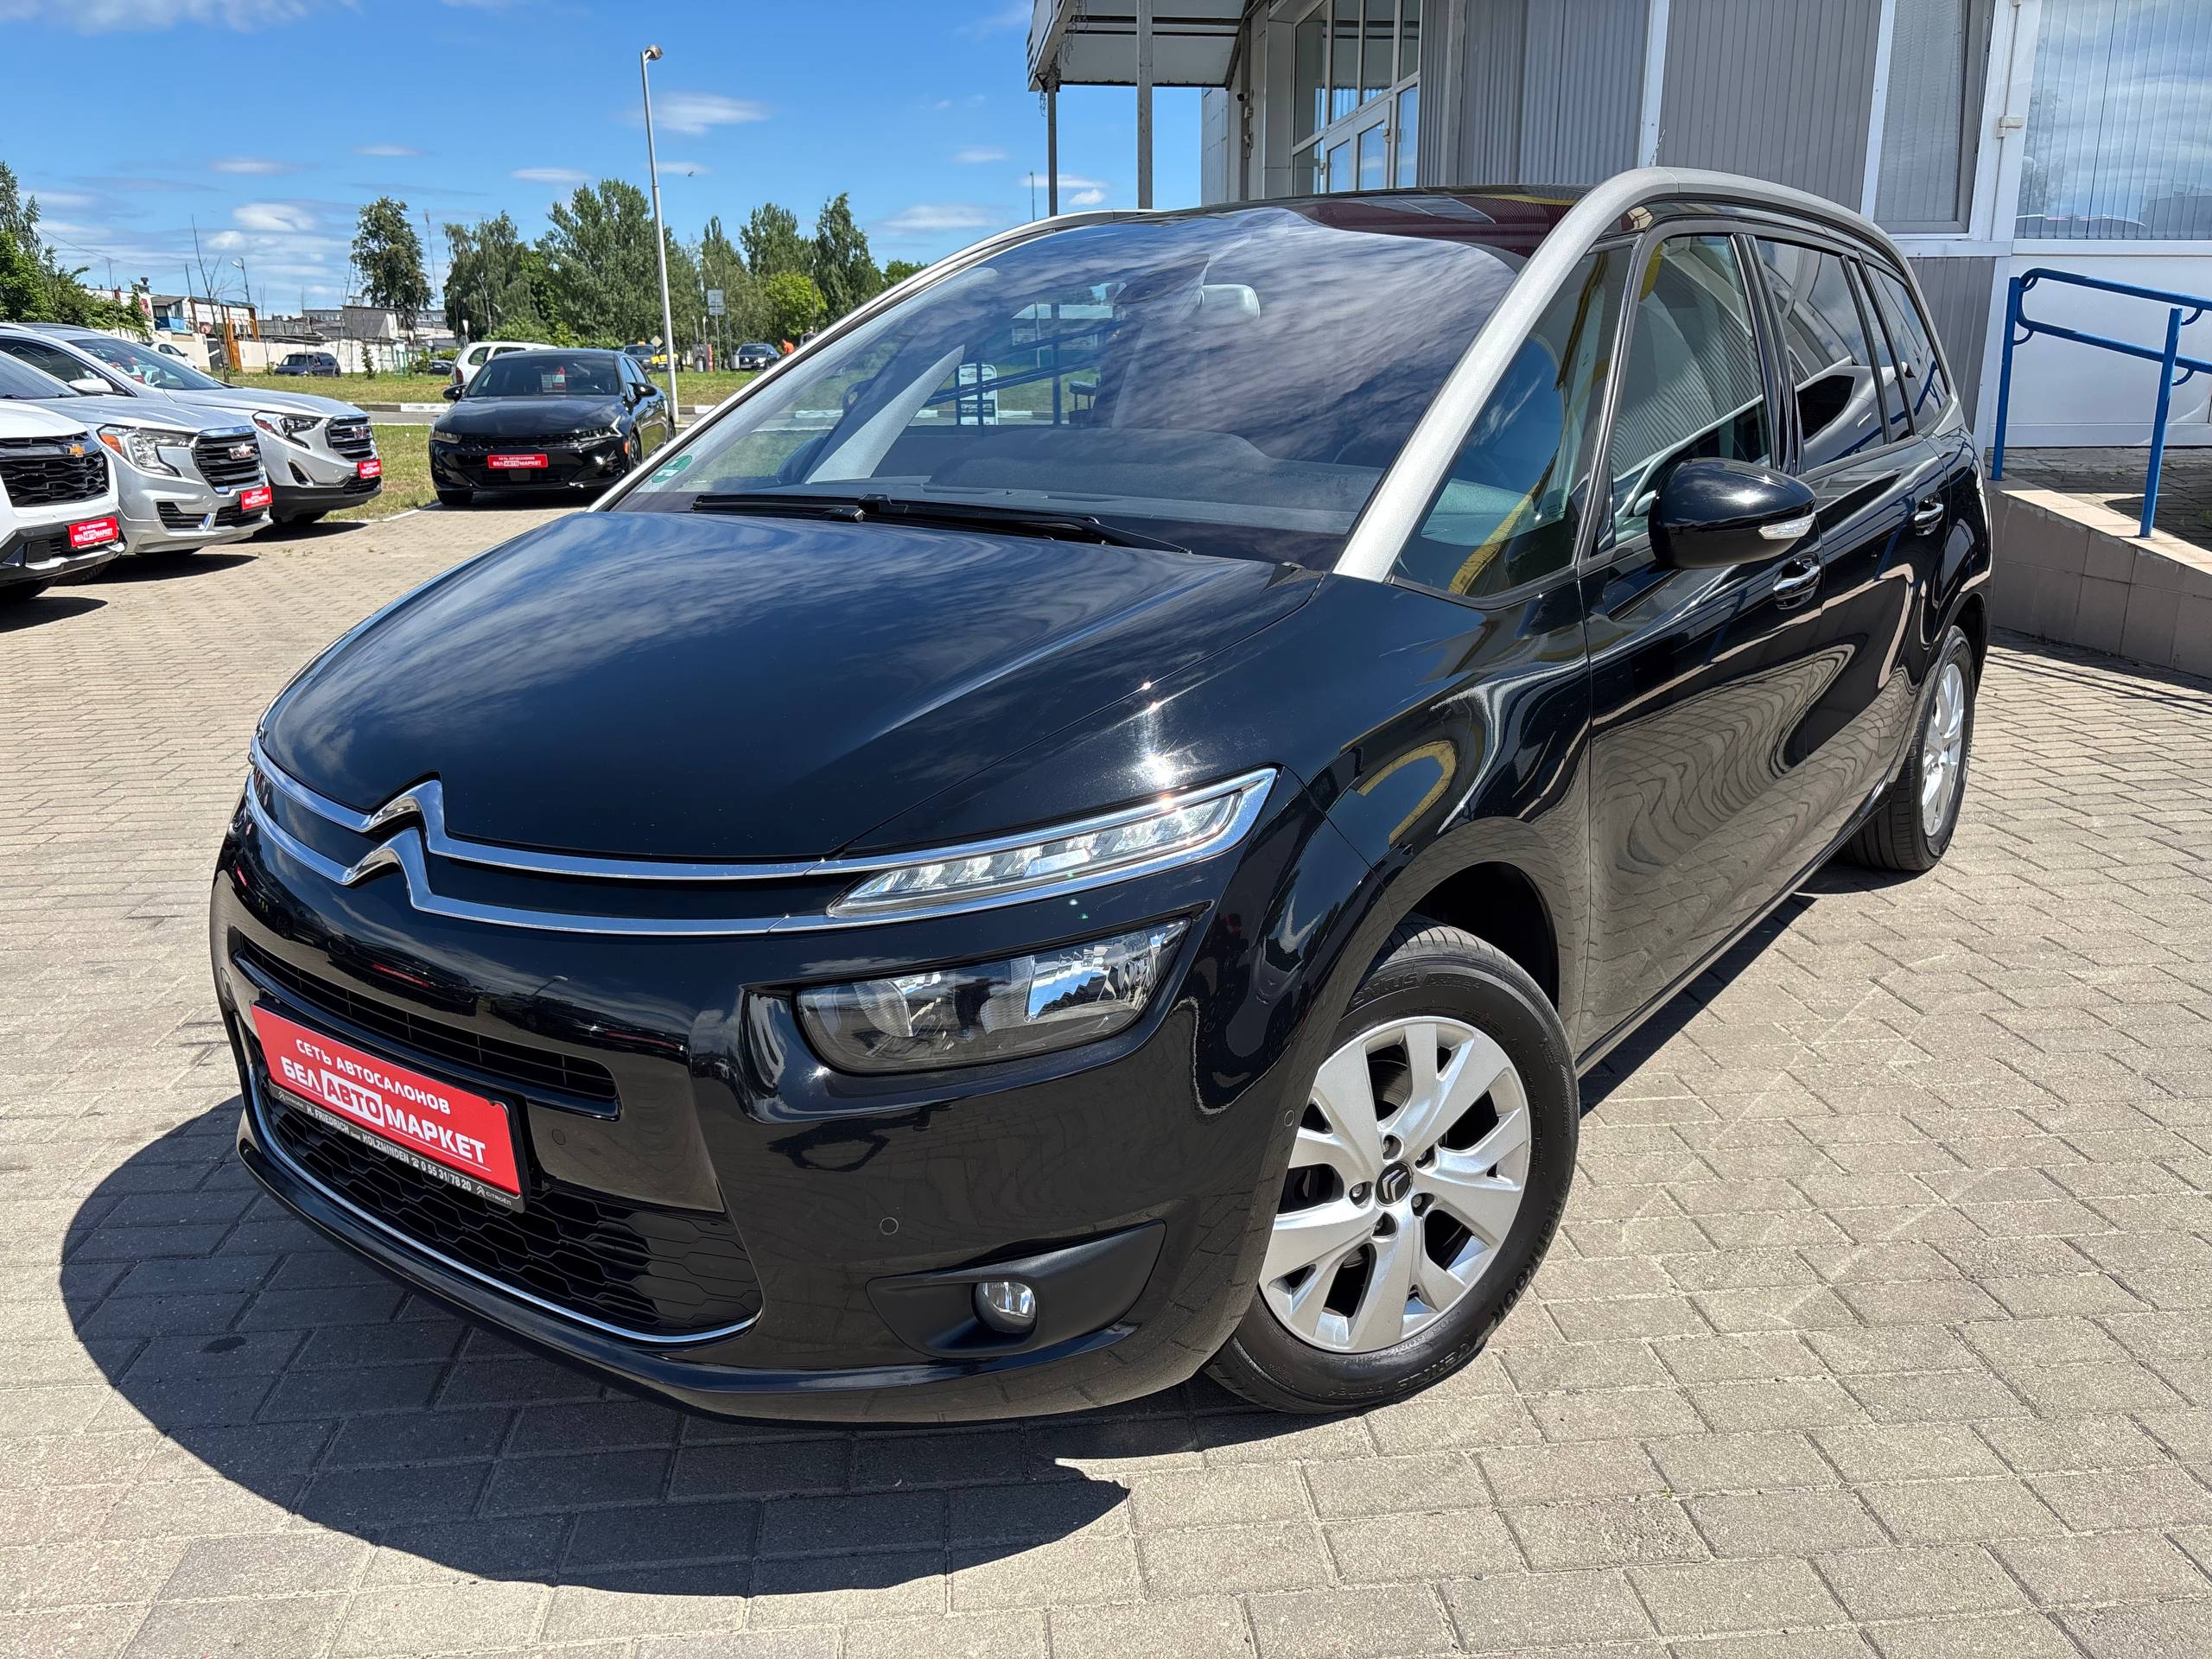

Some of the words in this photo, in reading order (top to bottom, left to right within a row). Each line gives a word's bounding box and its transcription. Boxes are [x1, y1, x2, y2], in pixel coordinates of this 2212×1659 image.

[296, 1039, 333, 1066] СЕТЬ
[336, 1057, 451, 1115] АВТОСАЛОНОВ
[315, 1109, 350, 1135] FRIEDRICH
[362, 1134, 410, 1164] HOLZMINDEN
